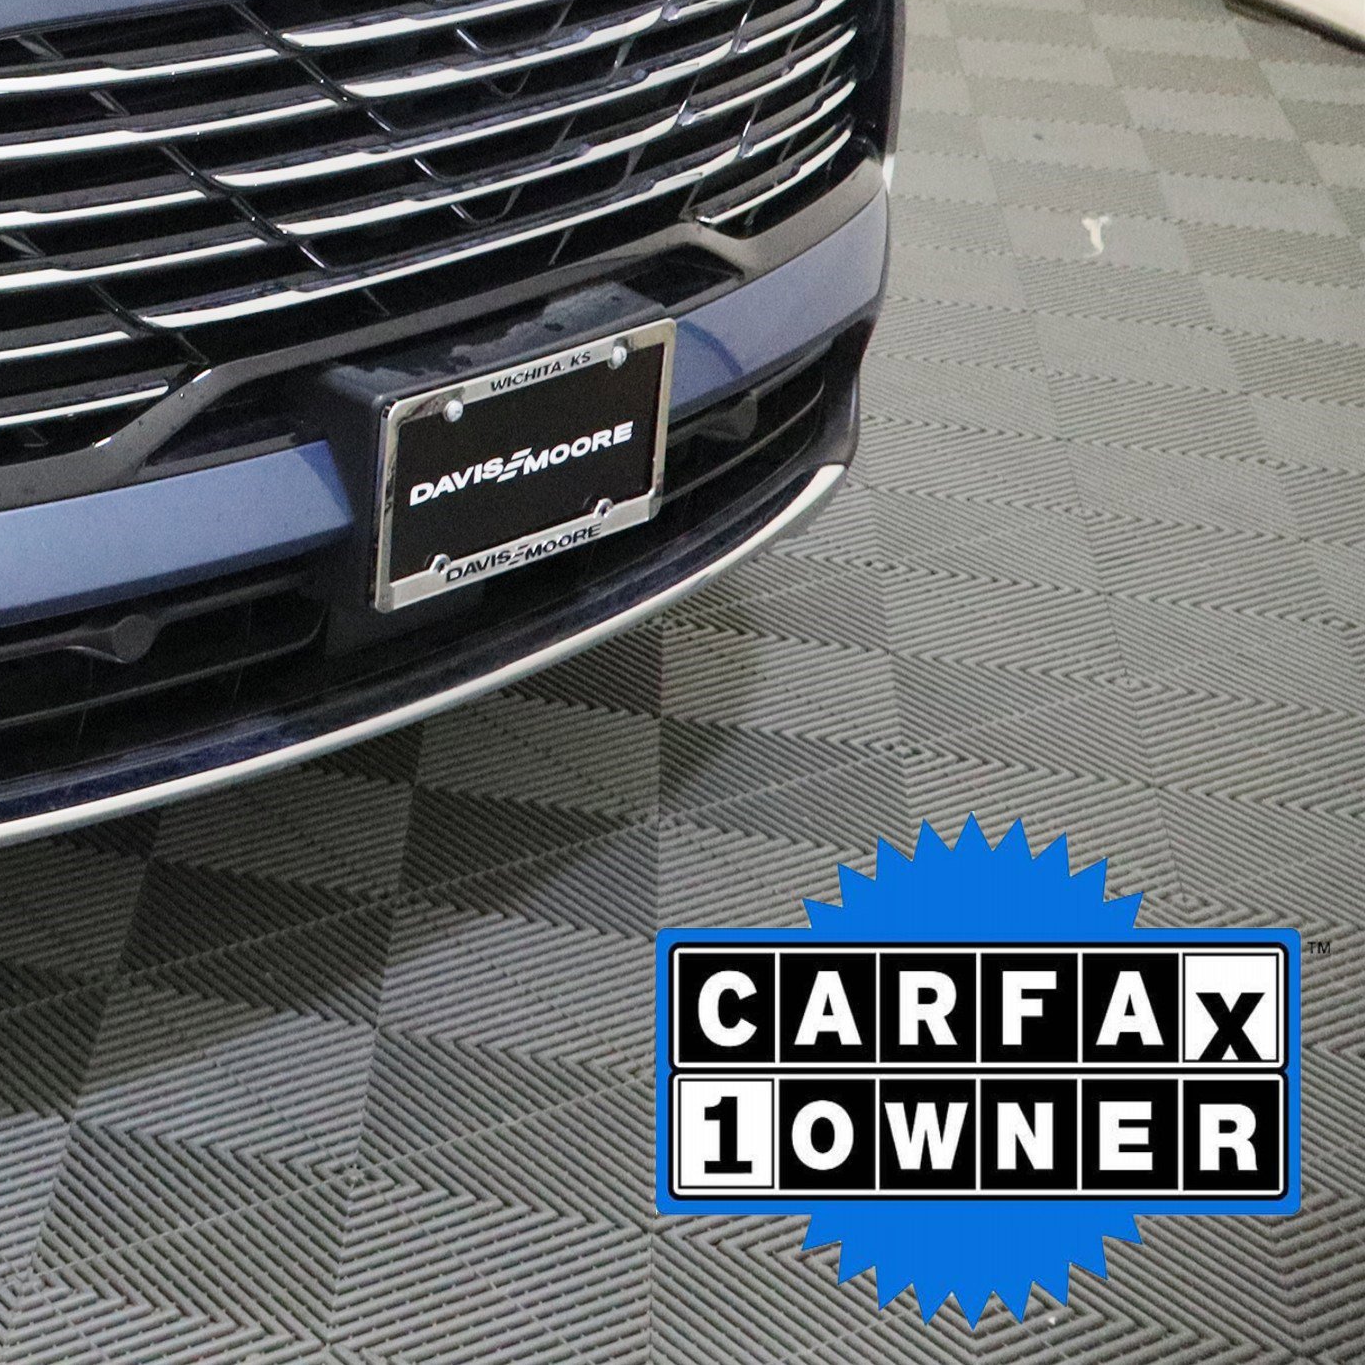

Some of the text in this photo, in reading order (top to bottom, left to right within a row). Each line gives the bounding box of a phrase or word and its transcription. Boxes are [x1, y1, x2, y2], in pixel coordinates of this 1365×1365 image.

[569, 350, 592, 368] KS
[409, 421, 634, 506] DAVIS MOORE
[444, 522, 603, 583] DAVIS MOORE
